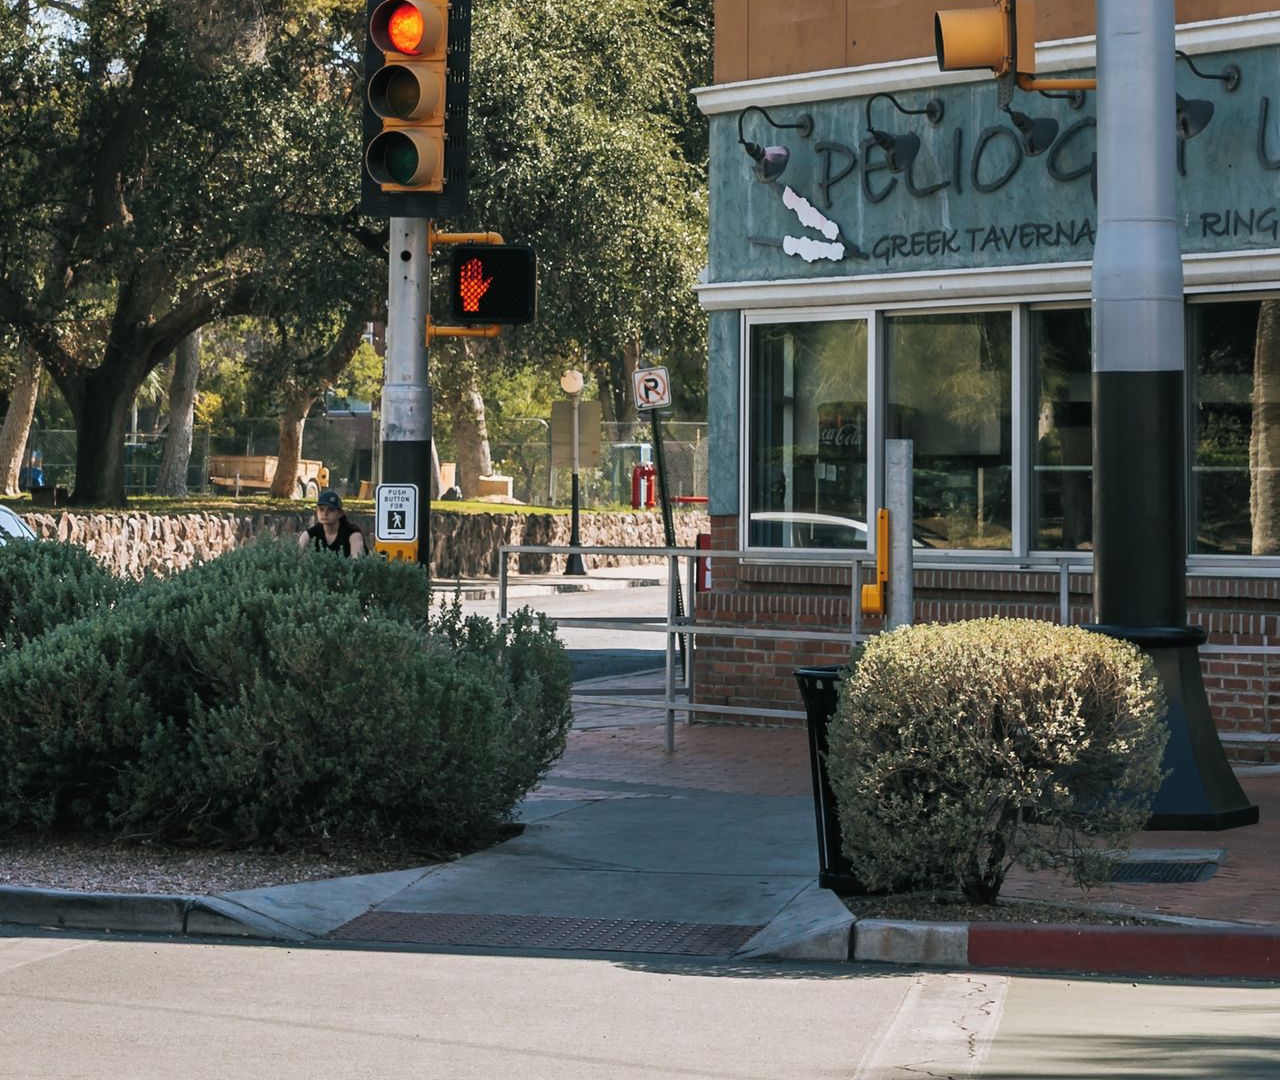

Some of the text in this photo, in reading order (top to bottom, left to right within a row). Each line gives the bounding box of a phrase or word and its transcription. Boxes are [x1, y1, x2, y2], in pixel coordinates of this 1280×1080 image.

[814, 124, 1024, 209] PELIO
[873, 228, 961, 266] GREEK
[967, 218, 1096, 253] TAVERNA
